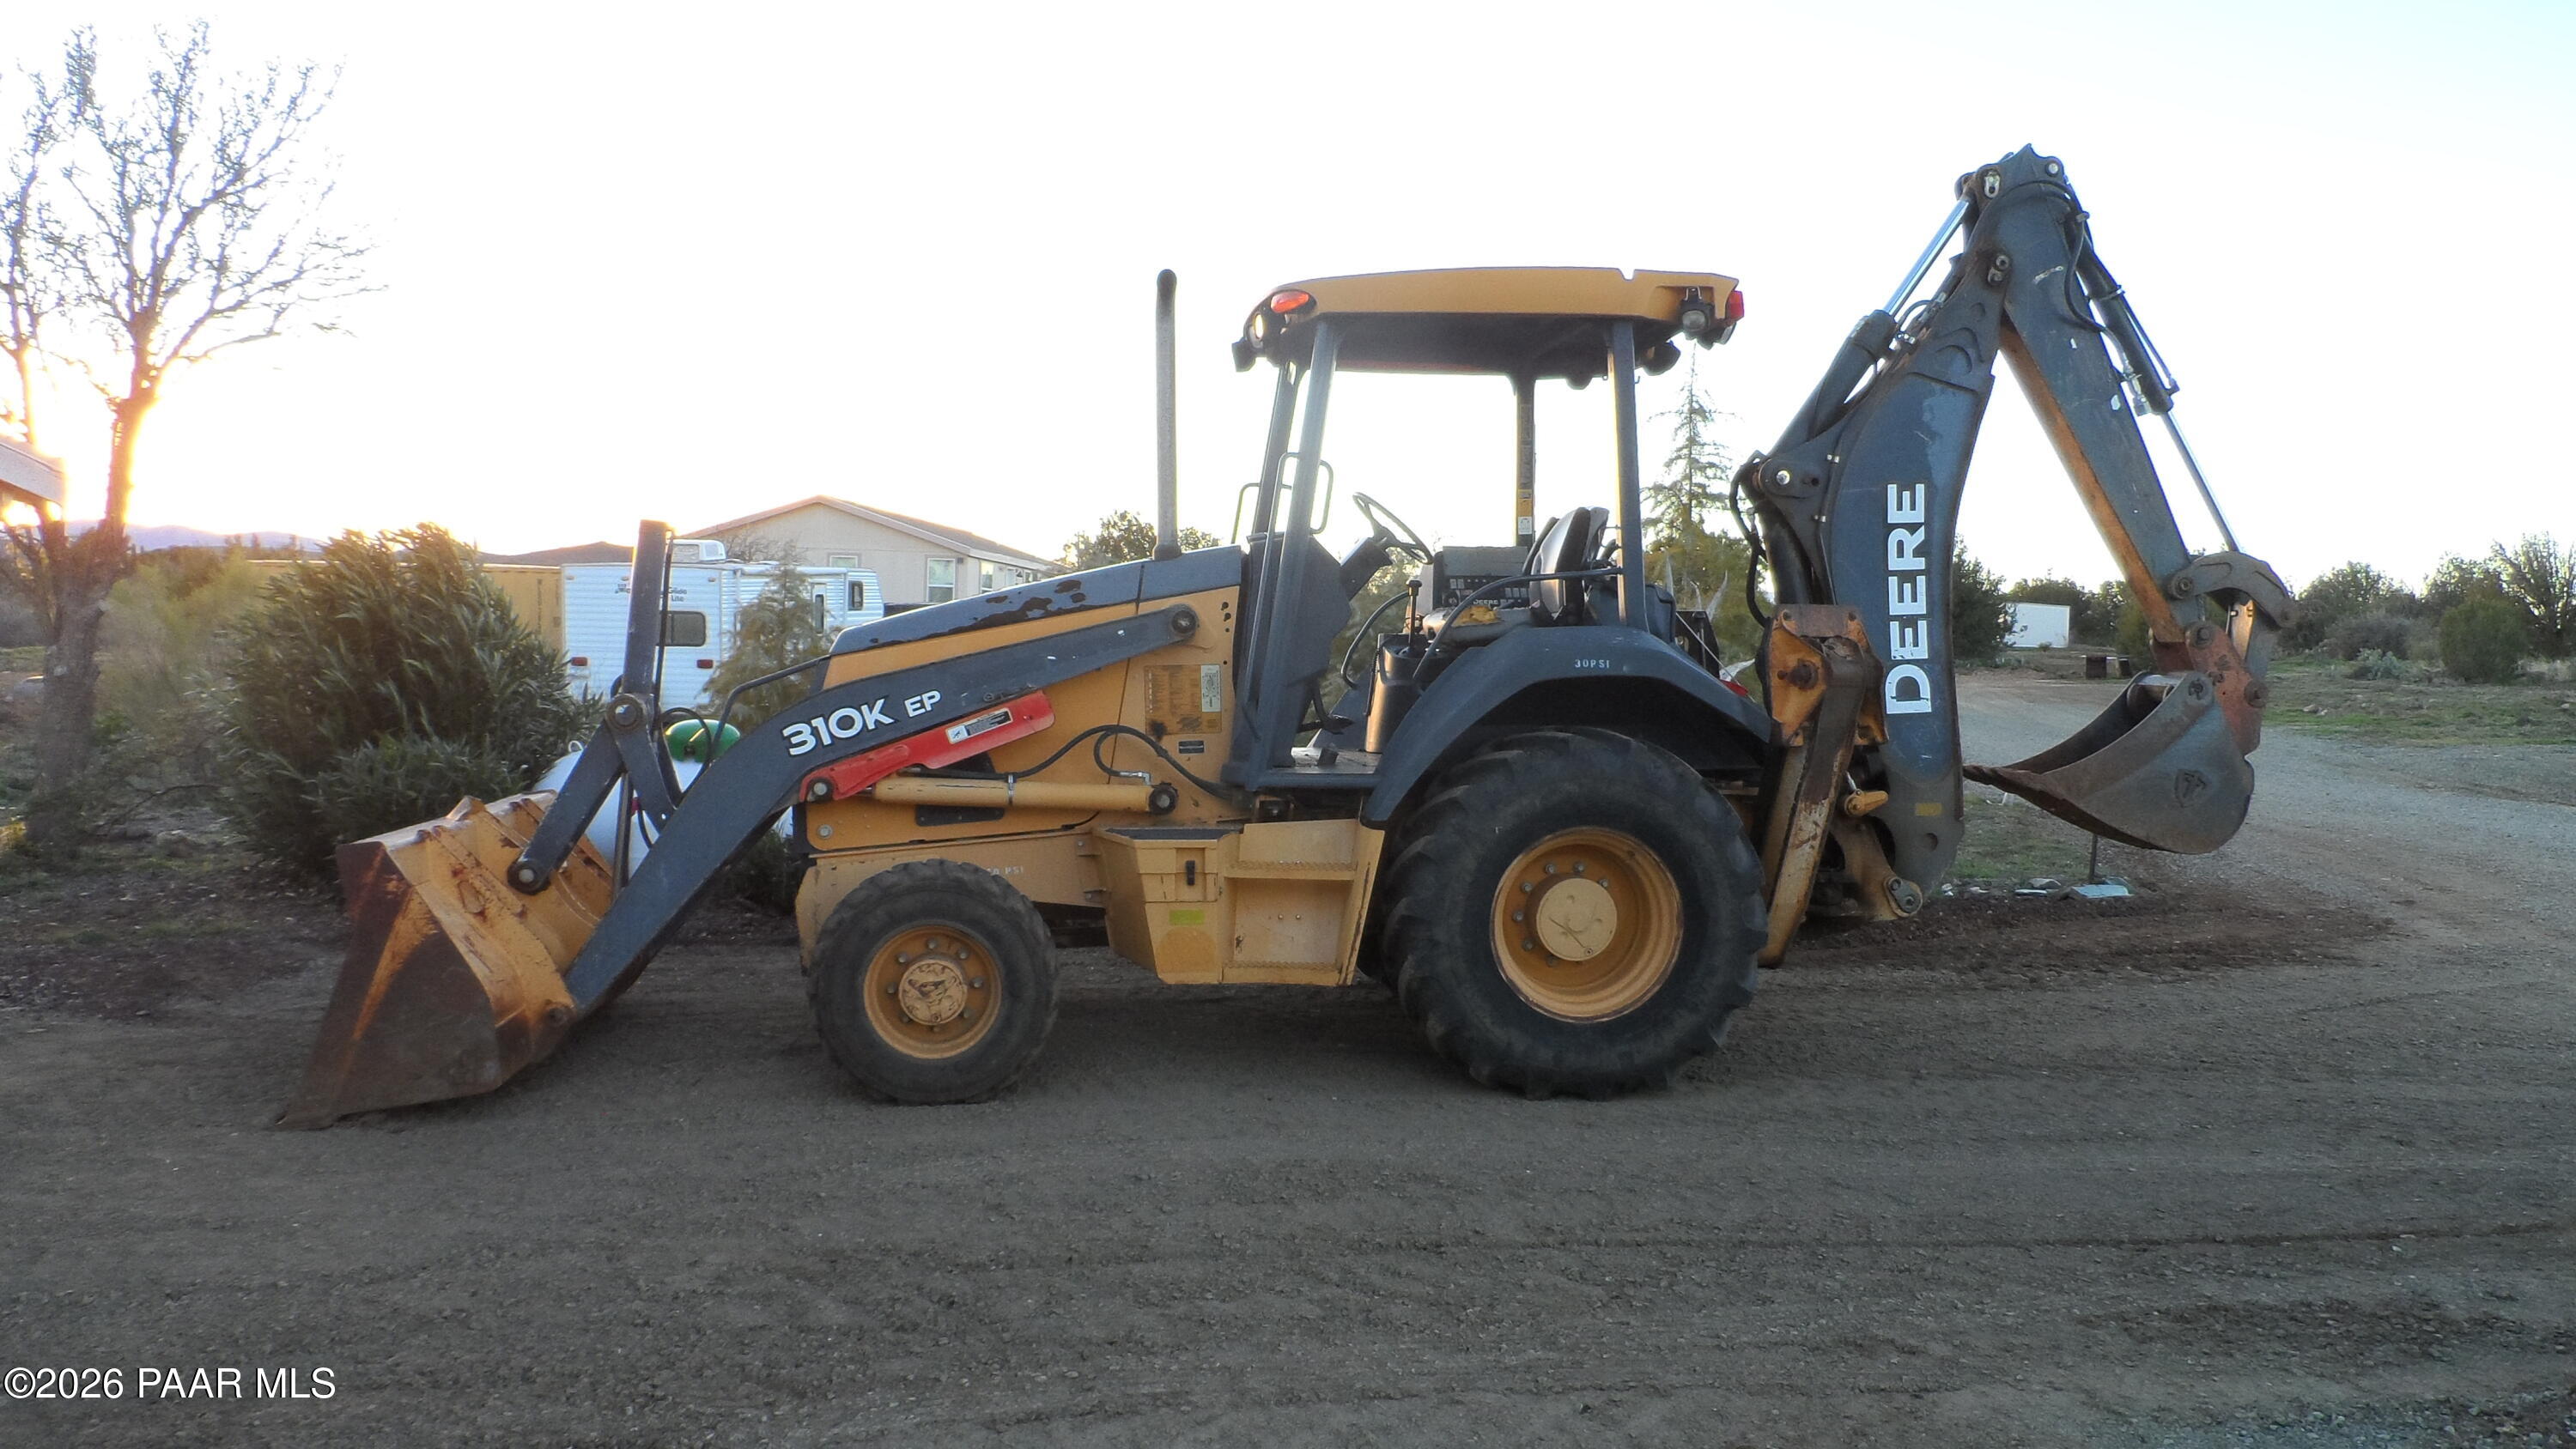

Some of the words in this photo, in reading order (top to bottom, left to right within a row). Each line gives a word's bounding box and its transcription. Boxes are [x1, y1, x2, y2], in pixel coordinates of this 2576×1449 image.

[1885, 483, 1932, 714] DEERE
[782, 698, 896, 755] 310K
[904, 689, 941, 718] EP
